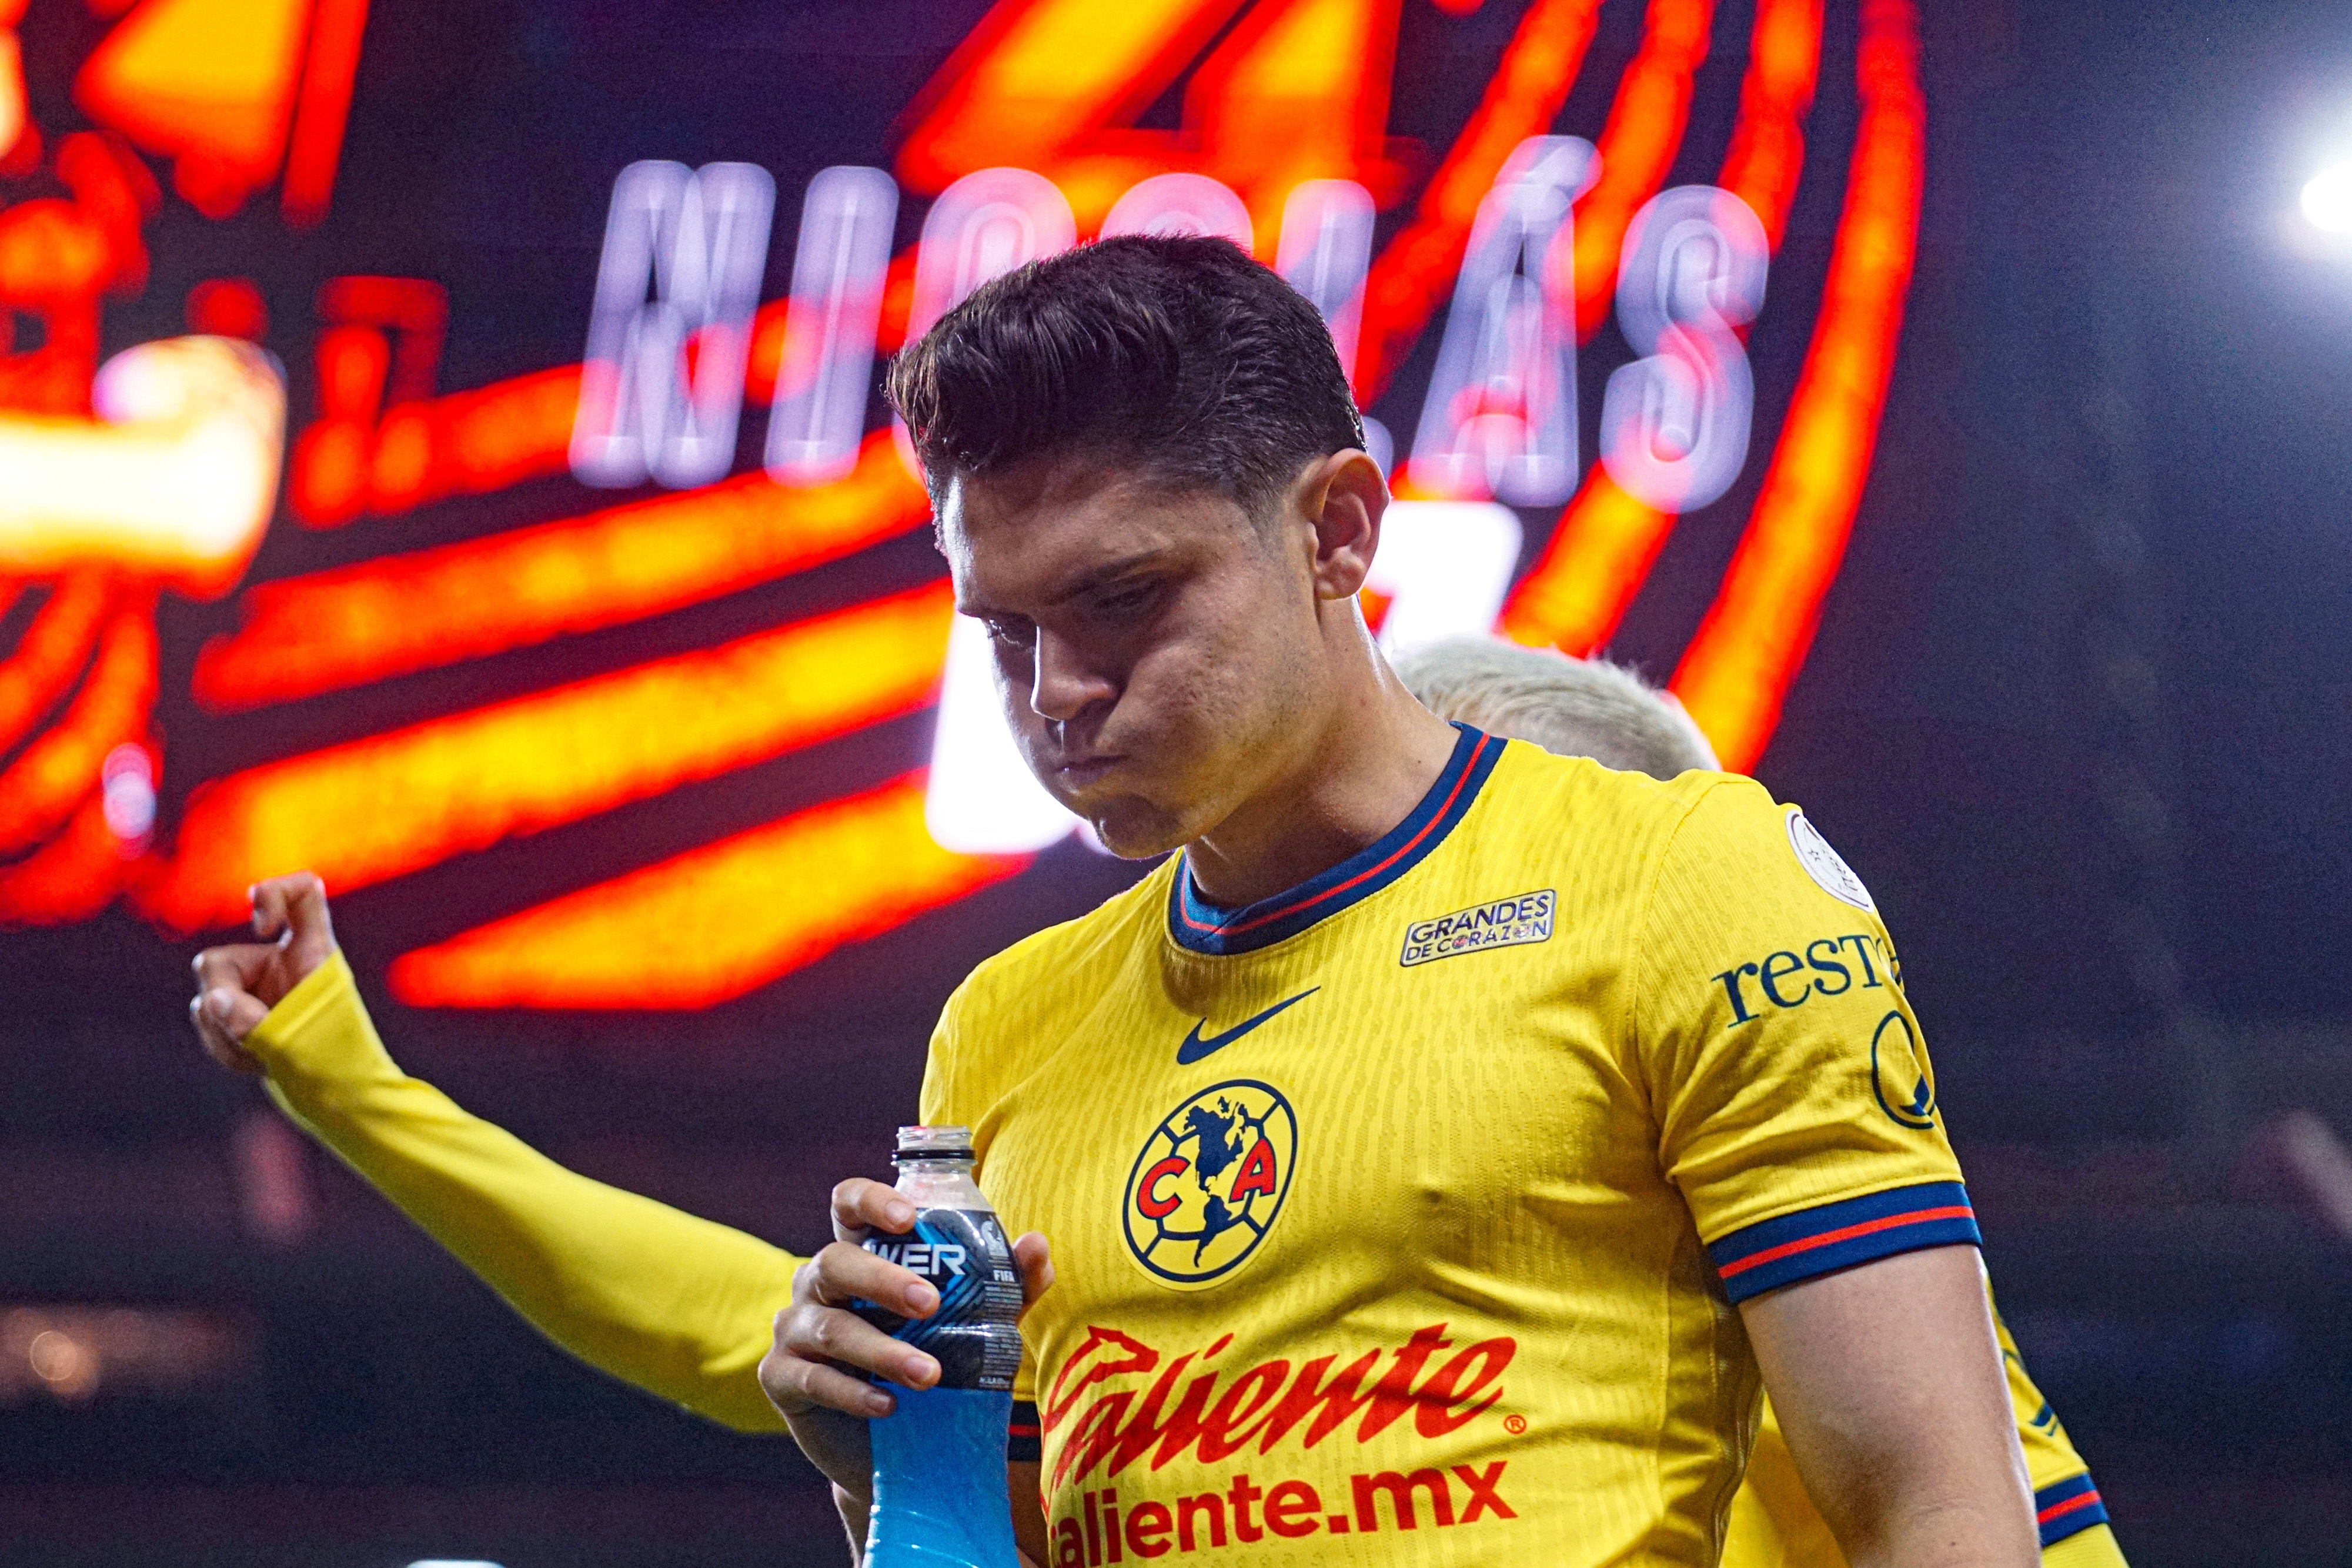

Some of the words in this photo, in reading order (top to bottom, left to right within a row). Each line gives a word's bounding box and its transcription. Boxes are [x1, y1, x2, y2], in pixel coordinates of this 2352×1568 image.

[567, 134, 1768, 511] NILÁS
[1405, 944, 1432, 961] DE
[1411, 894, 1550, 944] GRANDES
[1136, 1155, 1191, 1220] C
[1228, 1136, 1277, 1203] A
[1050, 1460, 1519, 1568] aliente.mx
